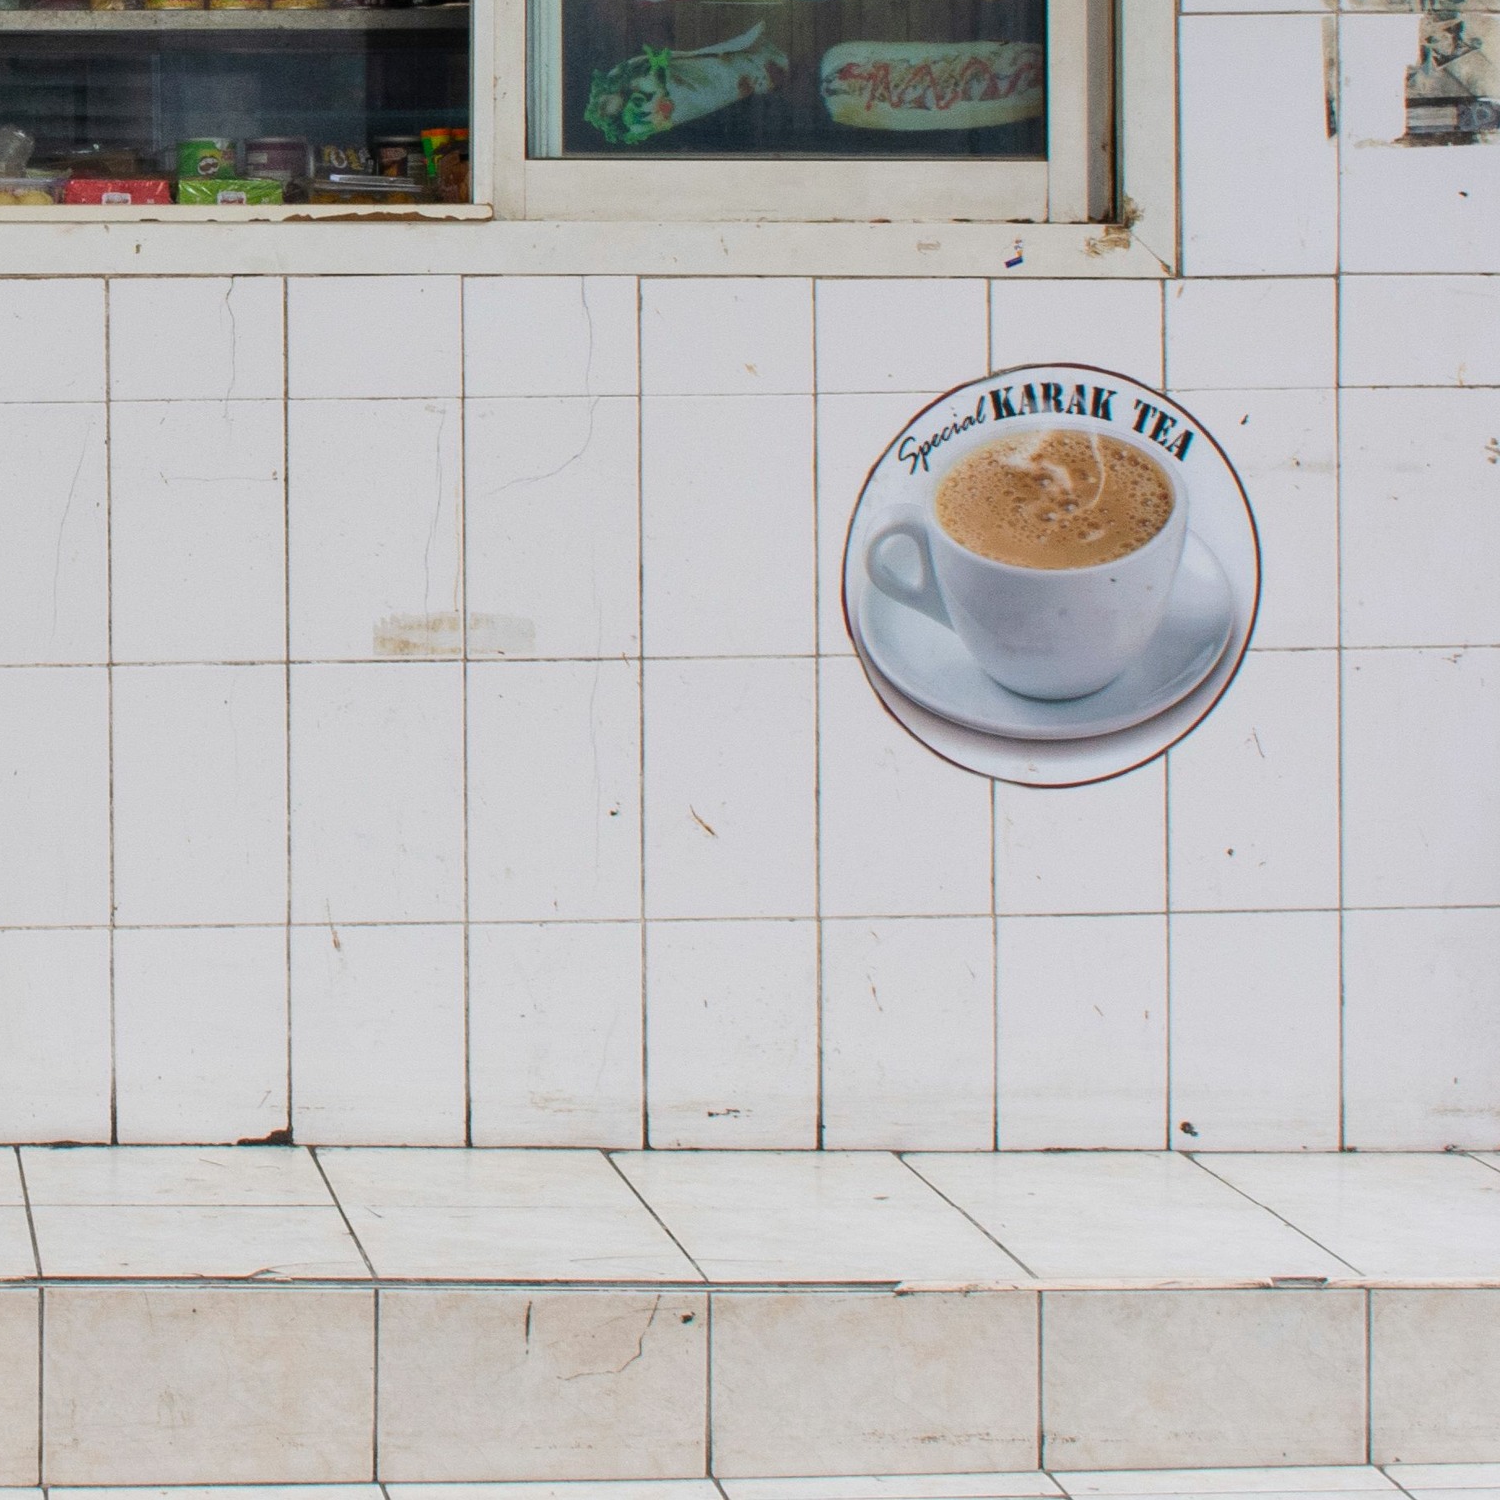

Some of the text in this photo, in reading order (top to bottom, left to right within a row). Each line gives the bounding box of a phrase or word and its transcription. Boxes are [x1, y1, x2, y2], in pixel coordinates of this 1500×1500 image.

[898, 381, 1195, 475] Special KARAK TEA
